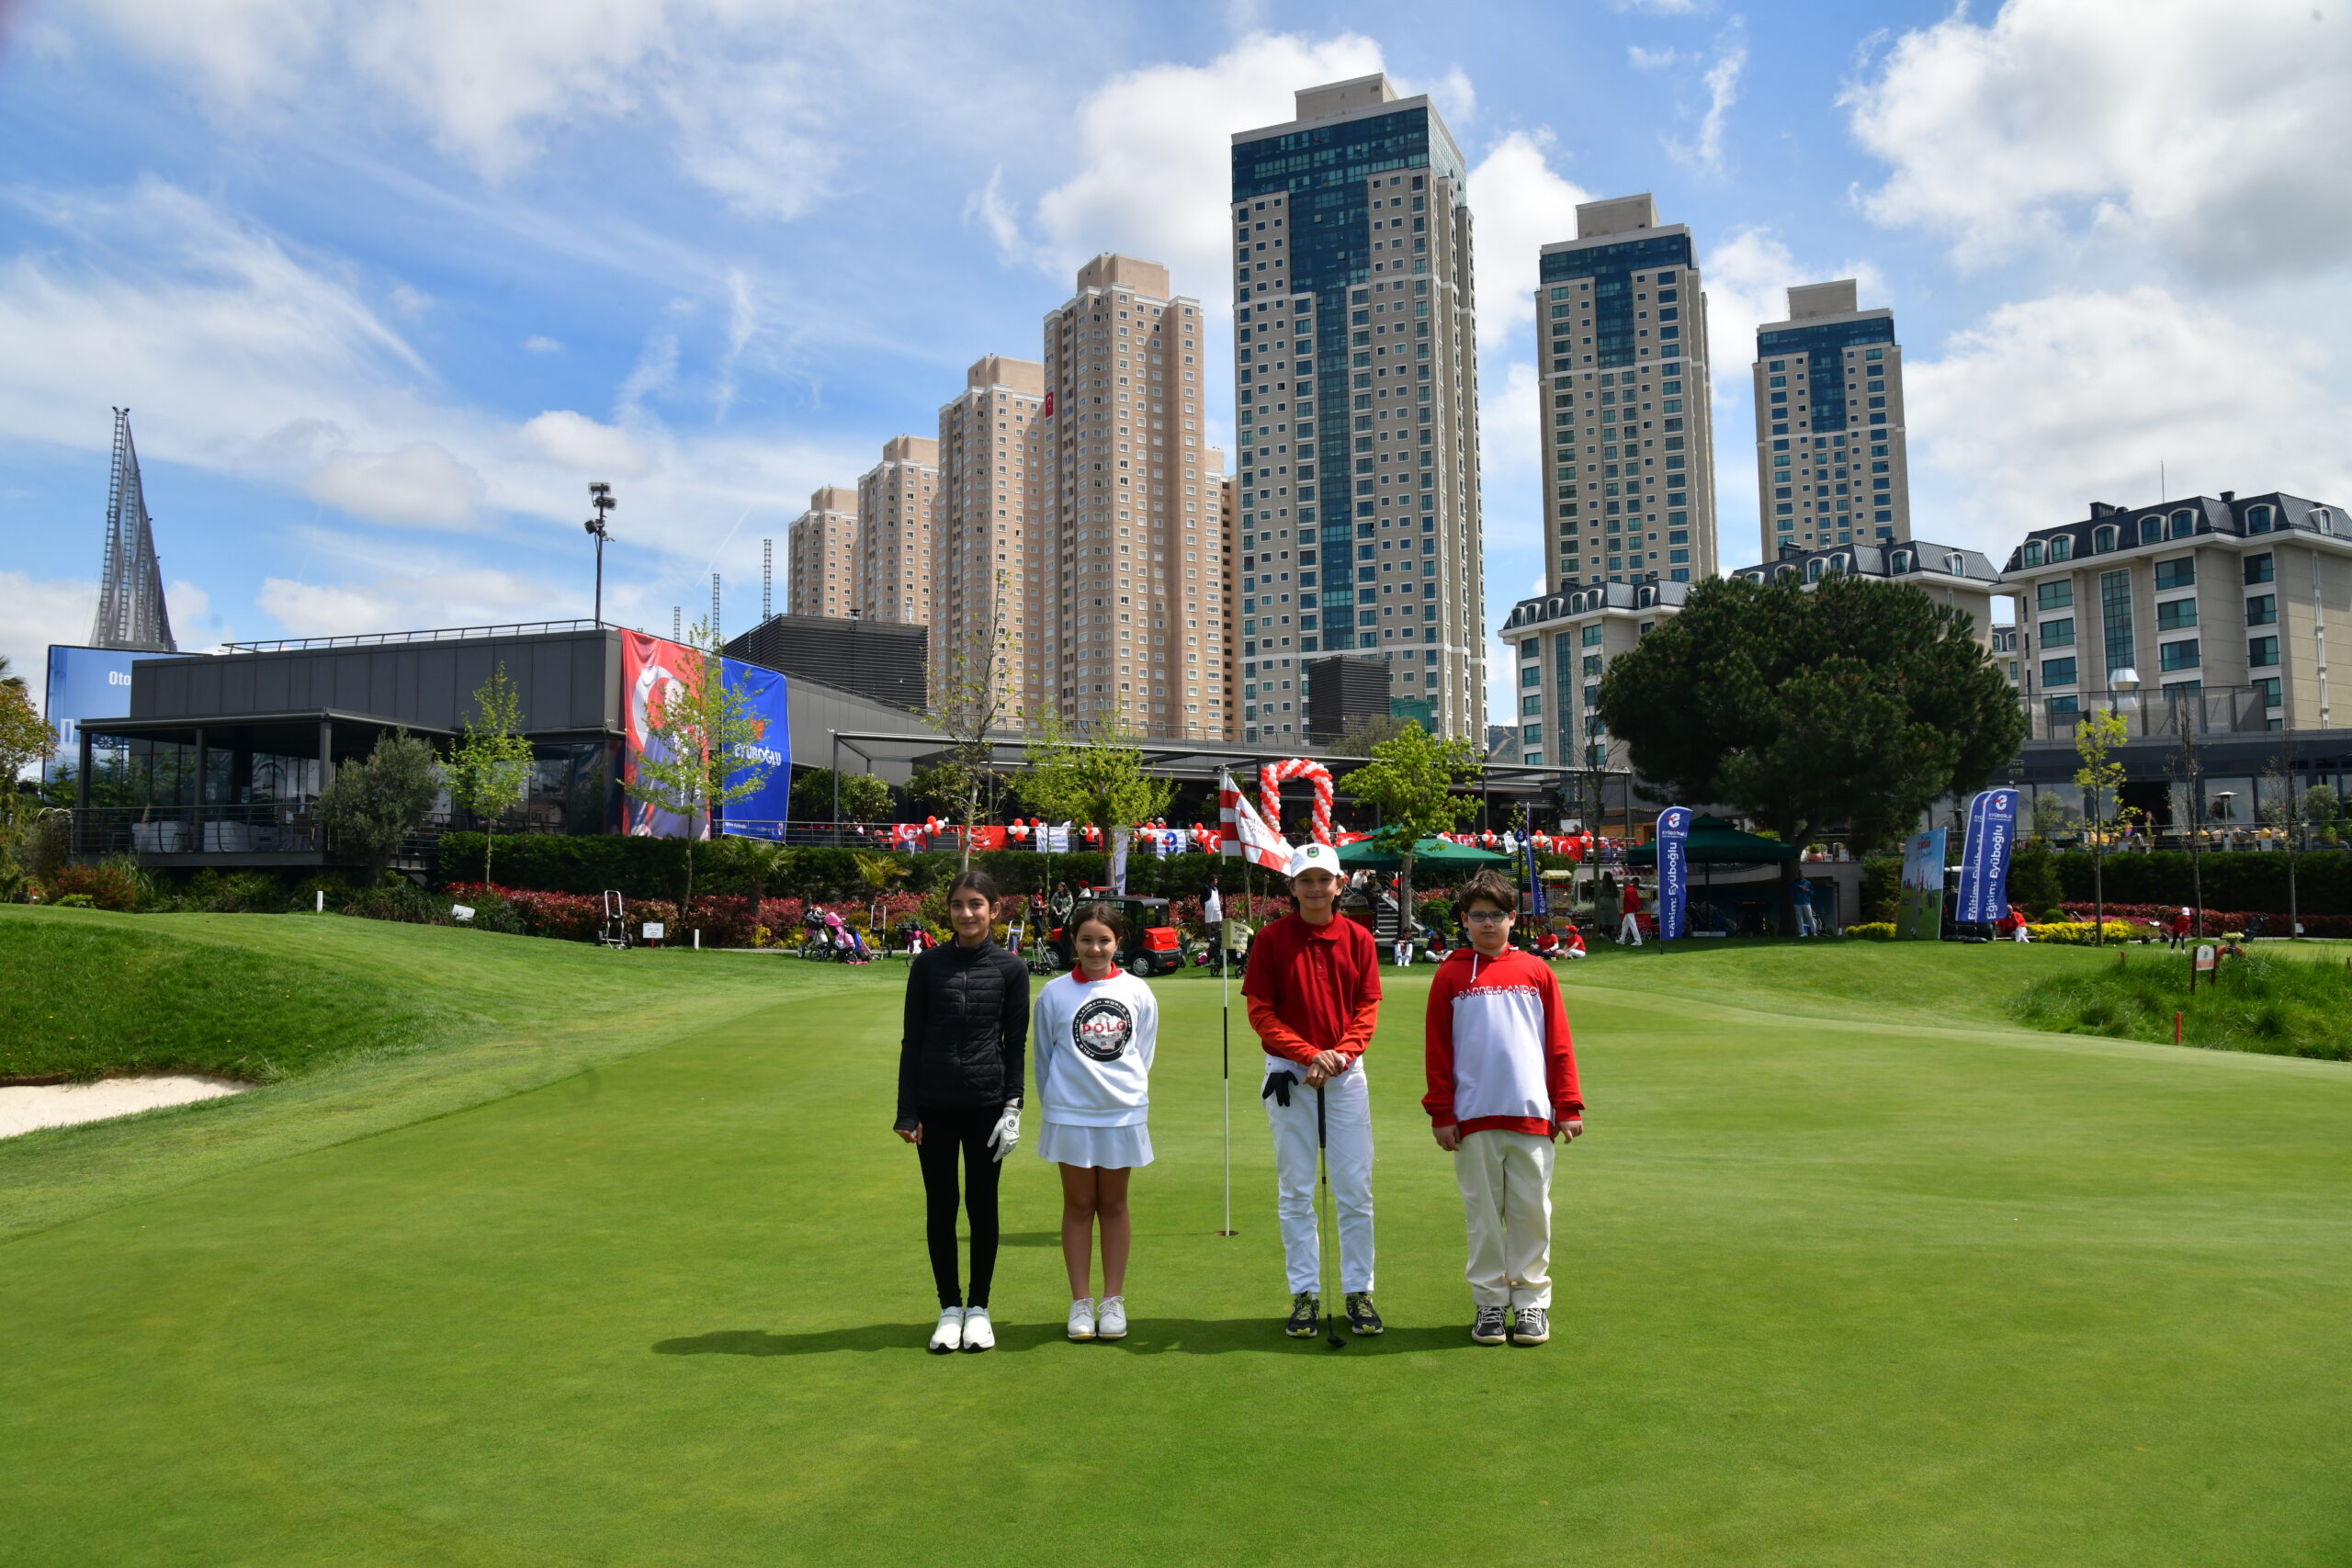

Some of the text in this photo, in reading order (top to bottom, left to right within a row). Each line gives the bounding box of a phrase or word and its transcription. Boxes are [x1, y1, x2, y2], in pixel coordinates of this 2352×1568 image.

[1989, 825, 2004, 878] Eyüboğlu
[1667, 842, 1679, 895] Eyüboğlu
[1986, 881, 1997, 919] Eğitim:
[1458, 986, 1502, 1000] BARRELS
[1079, 1000, 1102, 1017] LAUREN
[1103, 999, 1126, 1013] WORLD
[1080, 1021, 1126, 1035] POLO
